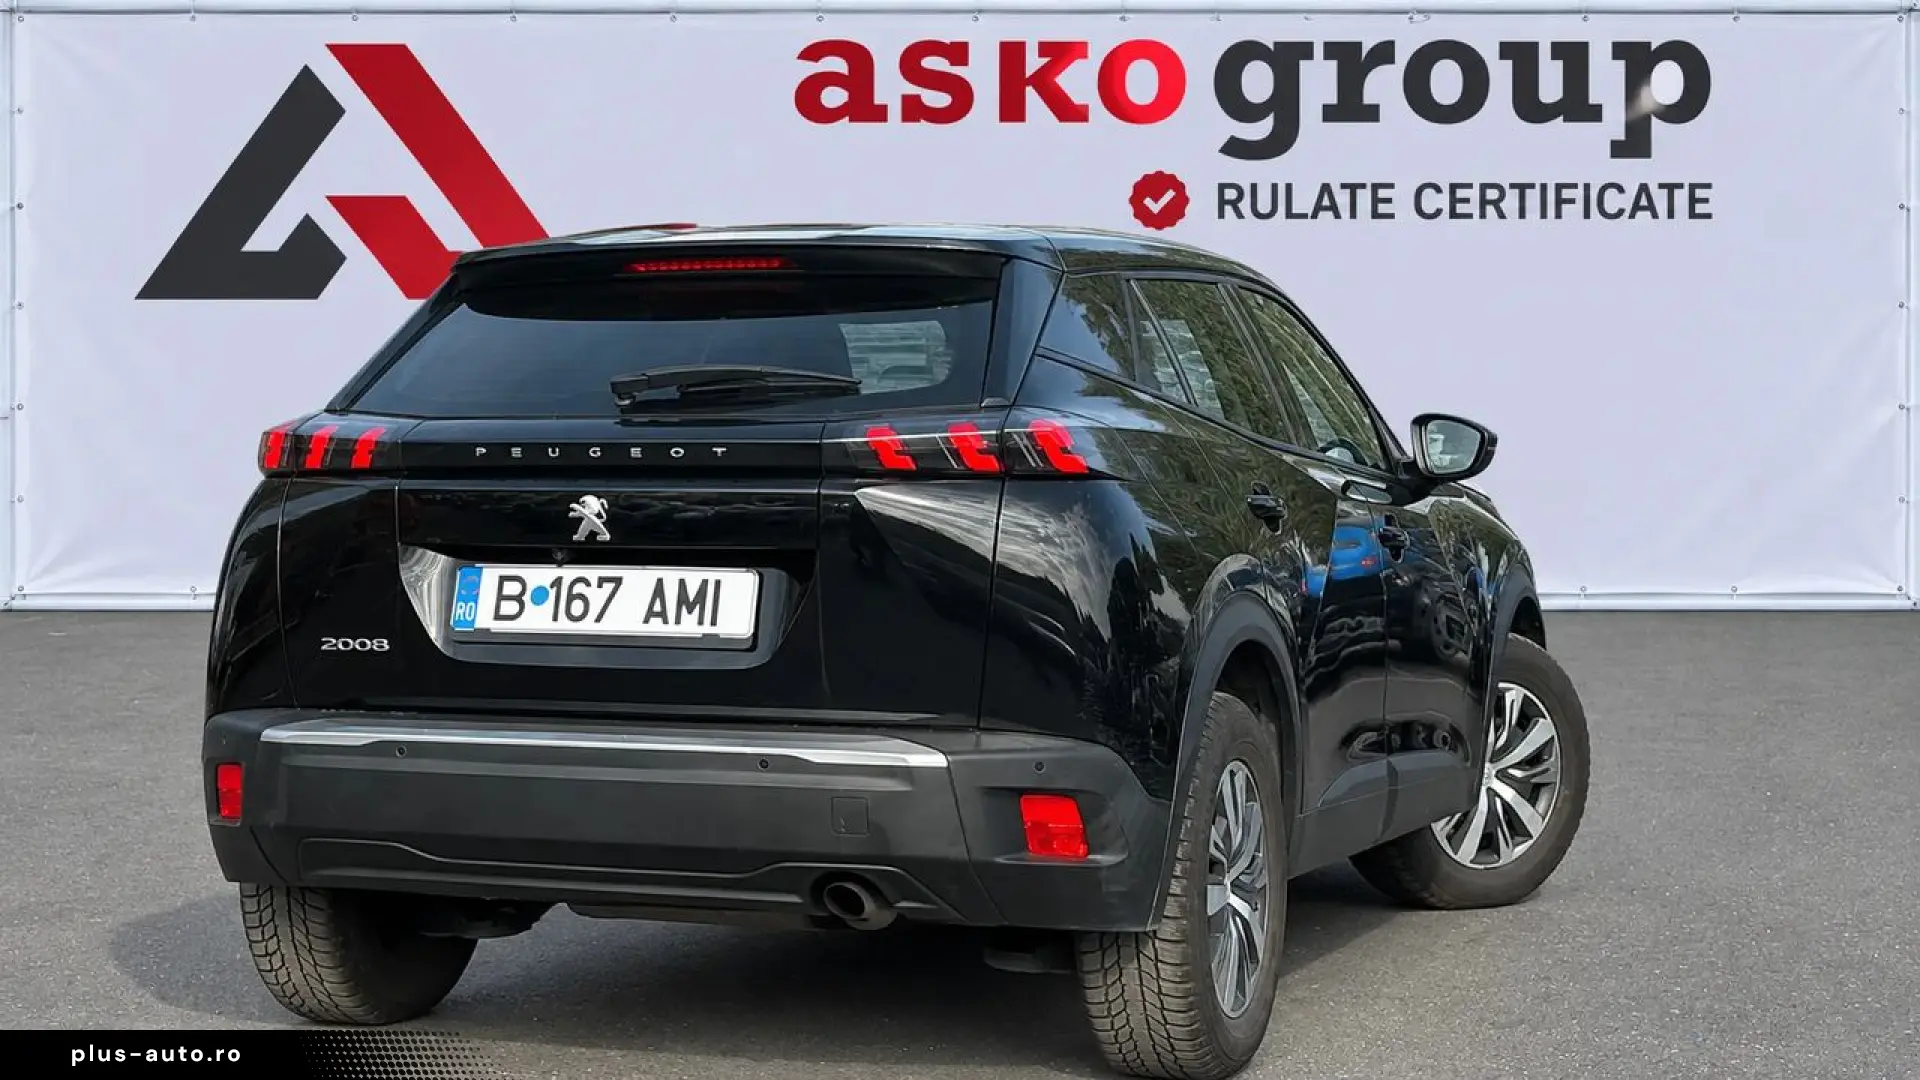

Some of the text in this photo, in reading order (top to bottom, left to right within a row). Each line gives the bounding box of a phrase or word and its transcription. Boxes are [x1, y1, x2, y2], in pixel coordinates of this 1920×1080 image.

[1214, 39, 1711, 160] group
[1218, 183, 1712, 220] RULATE CERTIFICATE
[476, 447, 727, 458] PEUGEOT
[455, 602, 476, 621] RO
[493, 575, 721, 627] B 167 AMI
[320, 637, 390, 651] 2008
